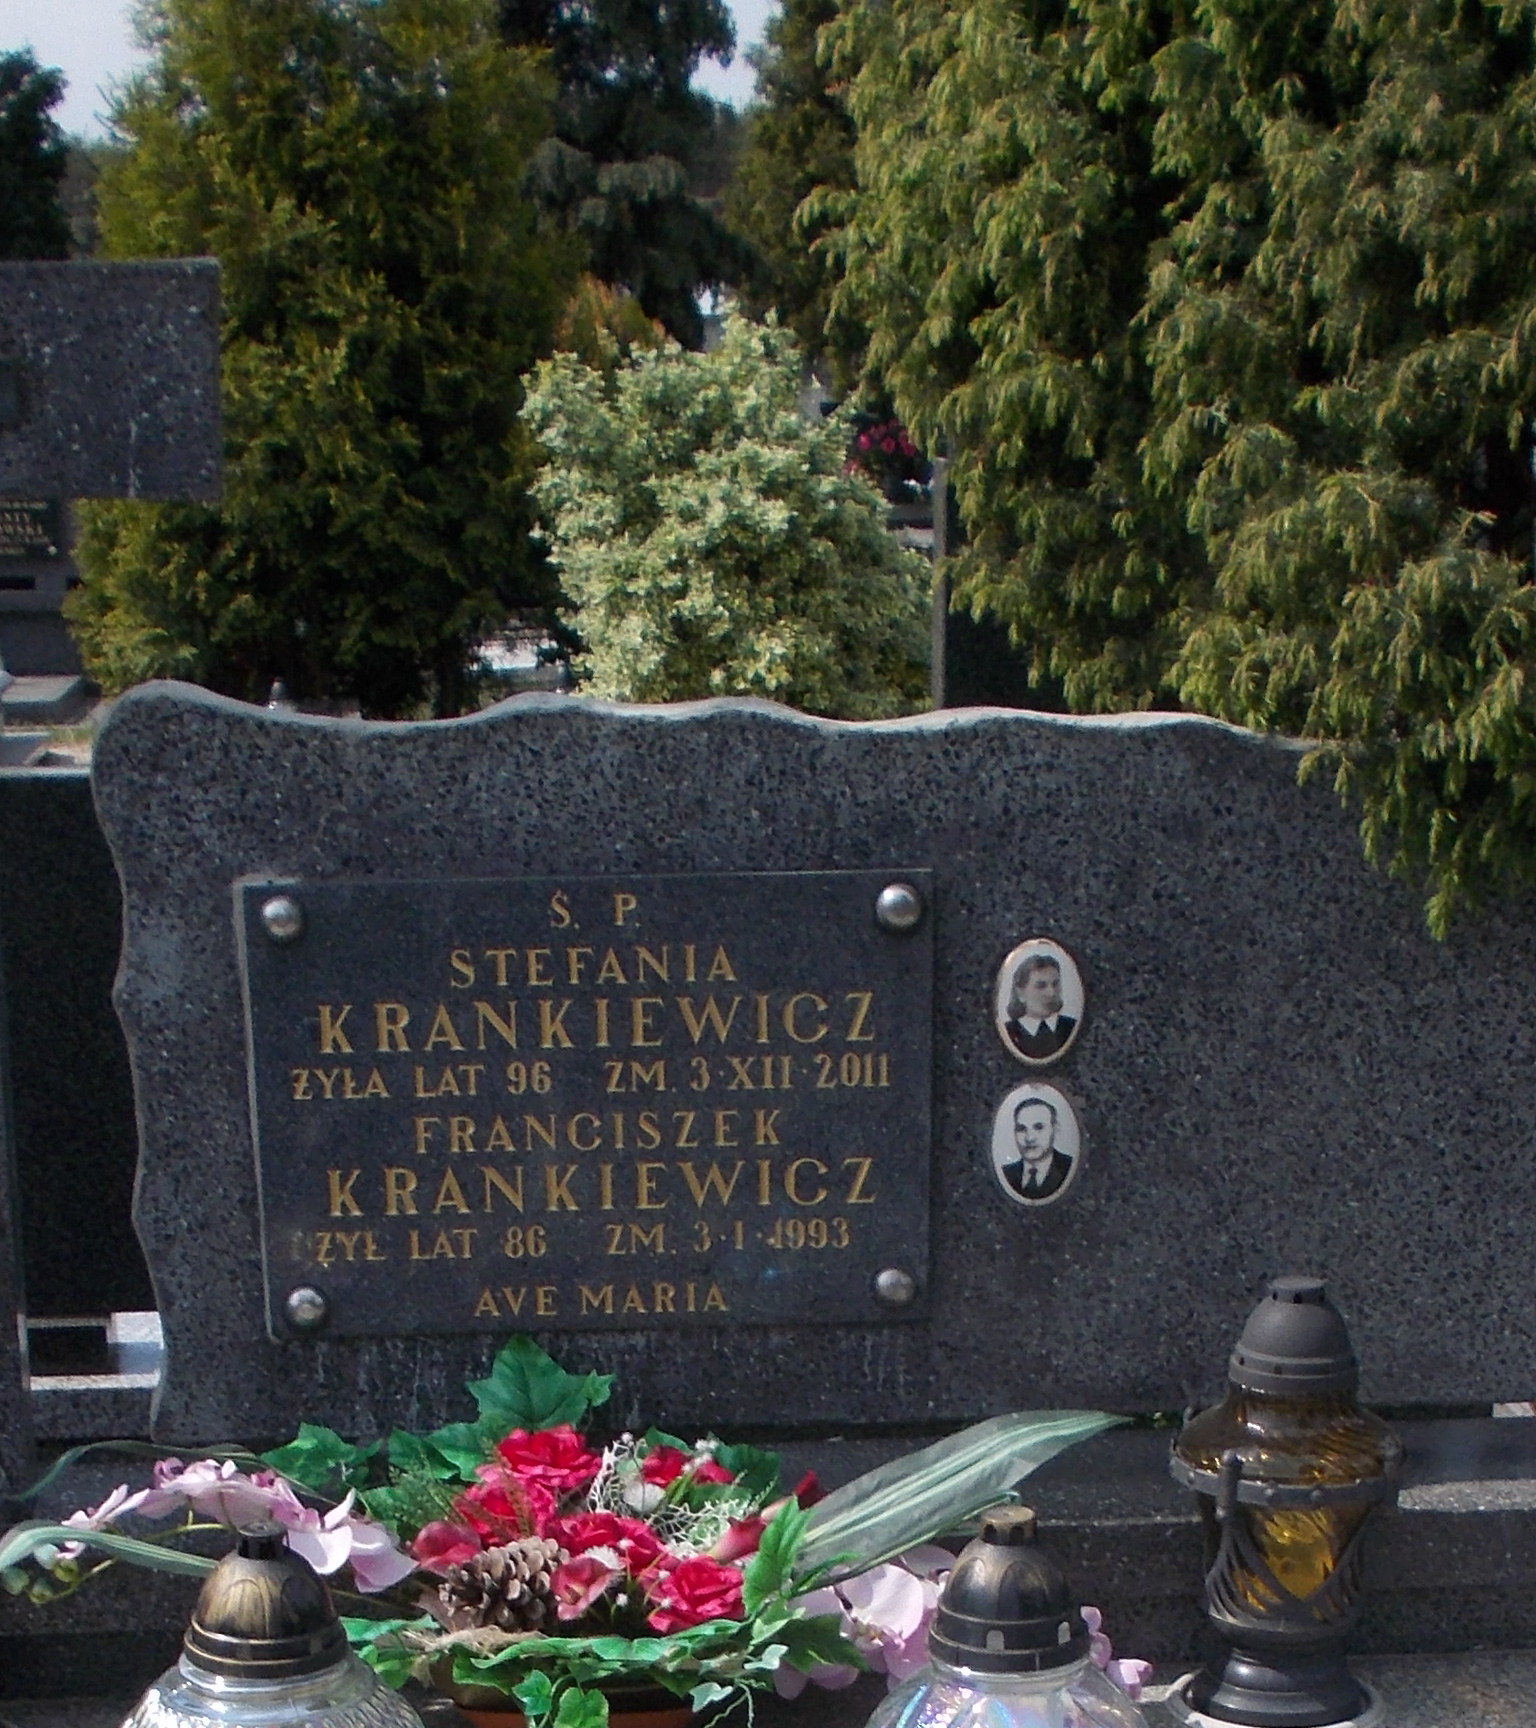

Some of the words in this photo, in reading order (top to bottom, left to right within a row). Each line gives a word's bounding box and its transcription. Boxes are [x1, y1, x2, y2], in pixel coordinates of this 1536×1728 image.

[613, 892, 642, 928] P.
[448, 945, 738, 988] STEFANIA
[317, 990, 877, 1055] KRANKIEWICZ
[413, 1065, 487, 1098] LAT
[505, 1060, 553, 1096] 96
[603, 1059, 677, 1094] ZM.
[414, 1109, 783, 1155] FRANCISZEK
[325, 1157, 879, 1218] KRANKIEWICZ
[408, 1227, 480, 1260] LAT
[504, 1225, 548, 1259] 86
[604, 1221, 678, 1255] ZM.
[472, 1285, 558, 1318] AVE
[580, 1281, 731, 1315] MARIA
